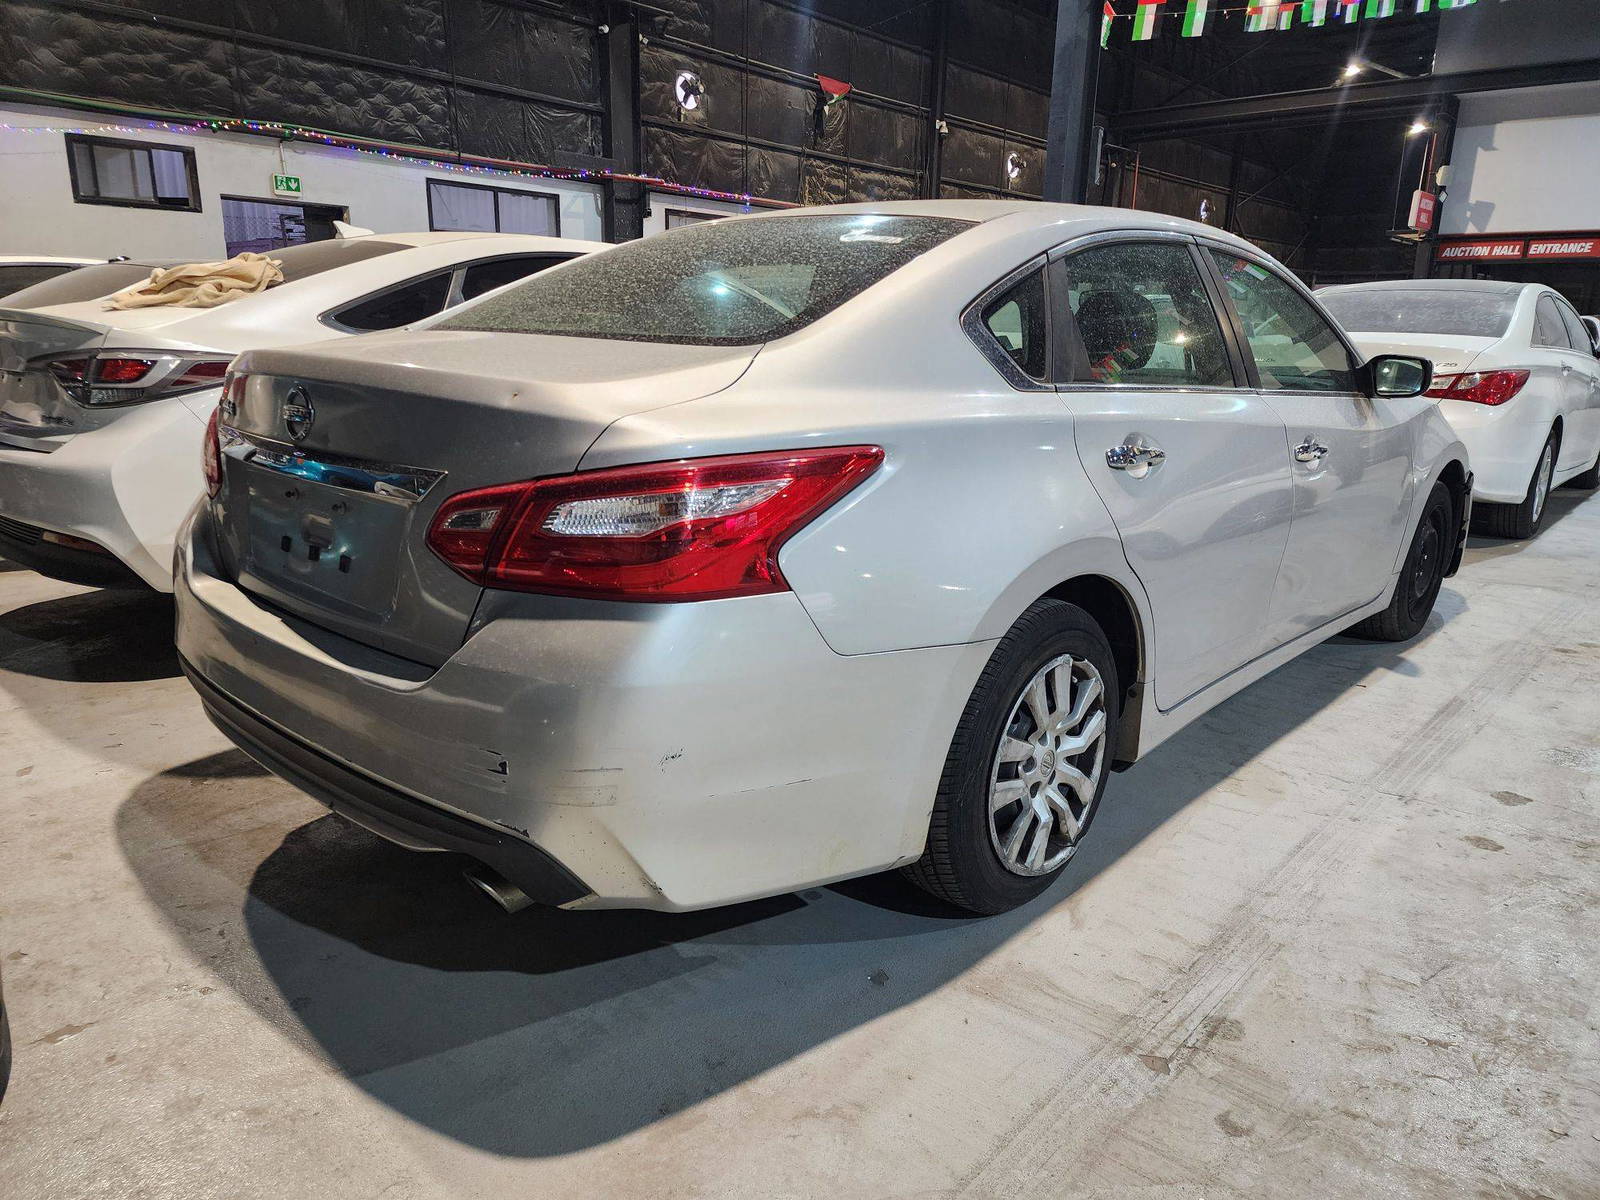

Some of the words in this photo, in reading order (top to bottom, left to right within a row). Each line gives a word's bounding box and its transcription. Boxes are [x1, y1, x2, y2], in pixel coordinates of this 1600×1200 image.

[1442, 246, 1490, 257] AUCTION
[1491, 245, 1521, 256] HALL
[1529, 242, 1594, 255] ENTRANCE
